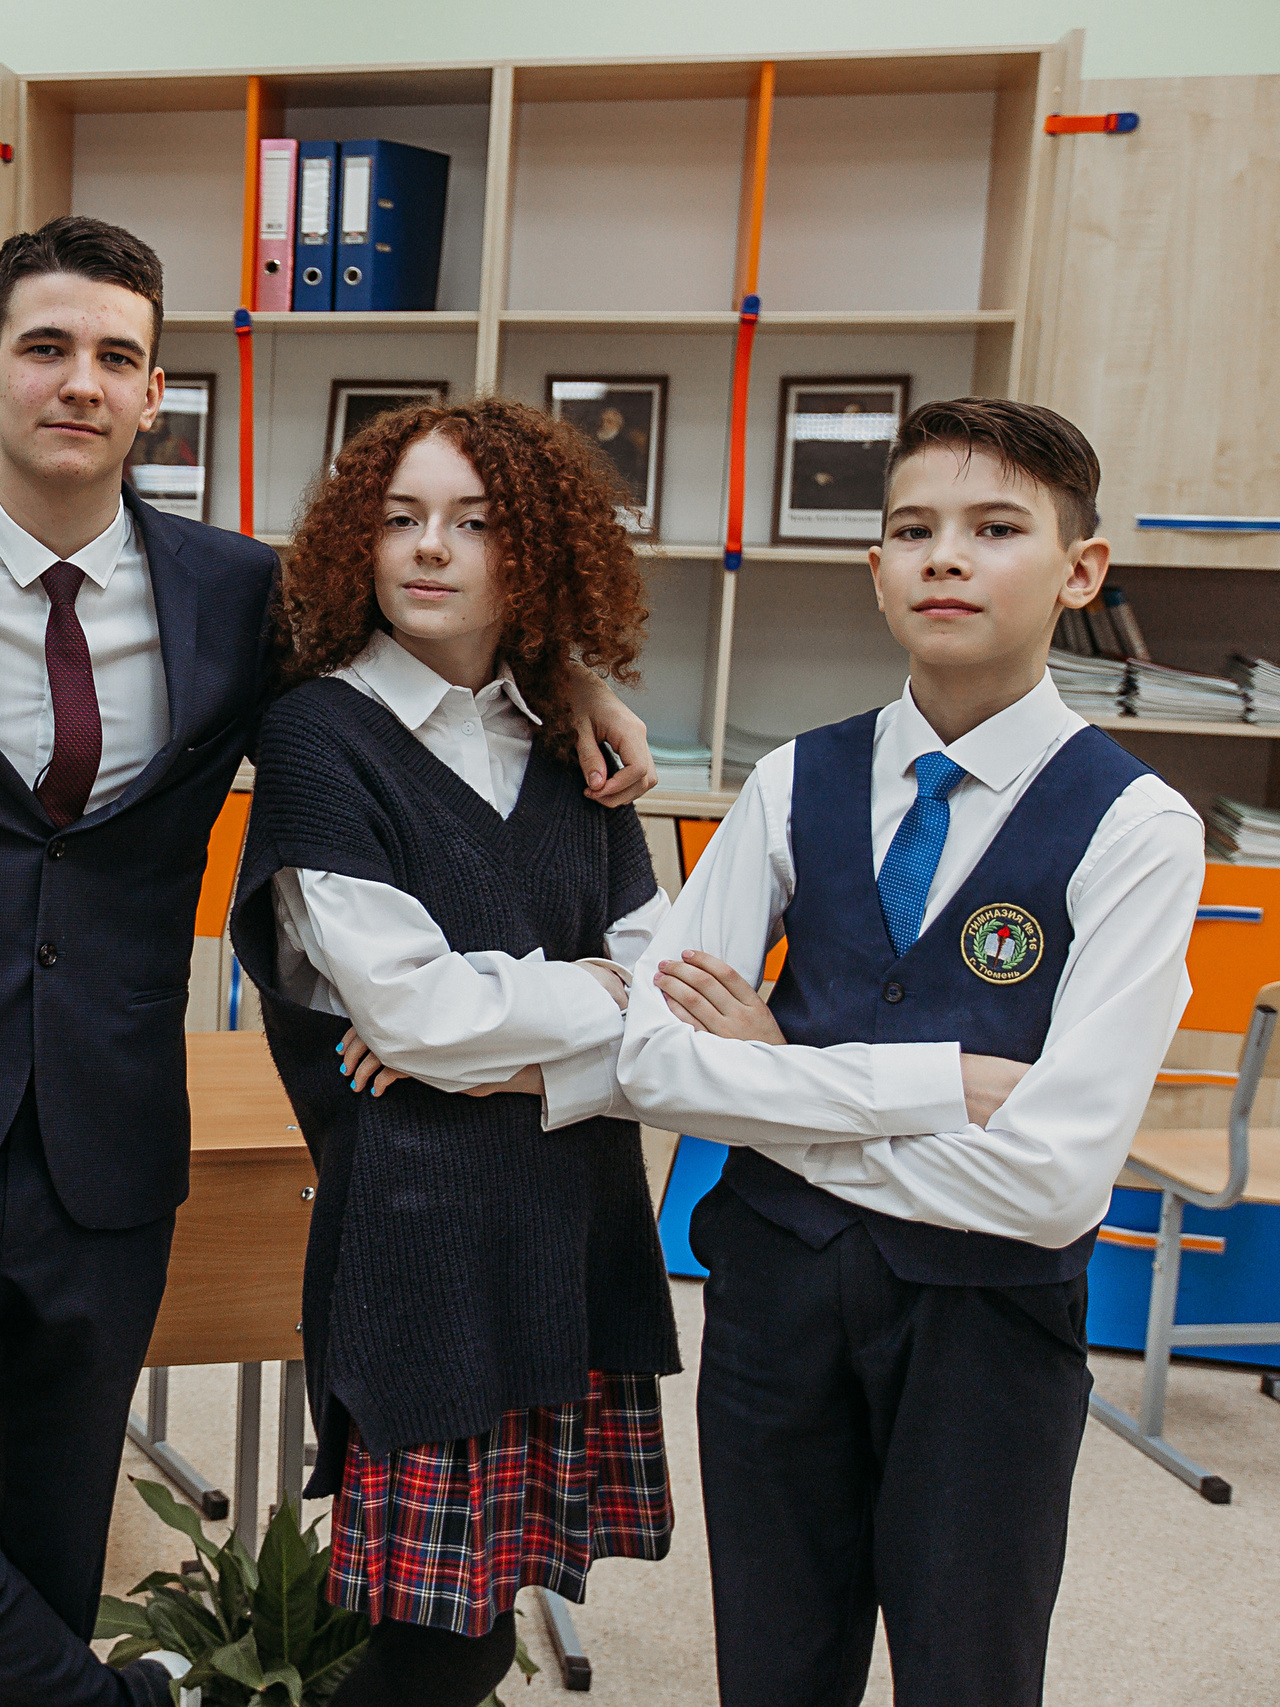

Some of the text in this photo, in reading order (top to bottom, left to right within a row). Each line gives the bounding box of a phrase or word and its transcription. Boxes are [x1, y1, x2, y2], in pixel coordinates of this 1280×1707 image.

[968, 909, 1038, 951] ГИМНАЗИЯ № 16
[979, 964, 1020, 979] Тюмень
